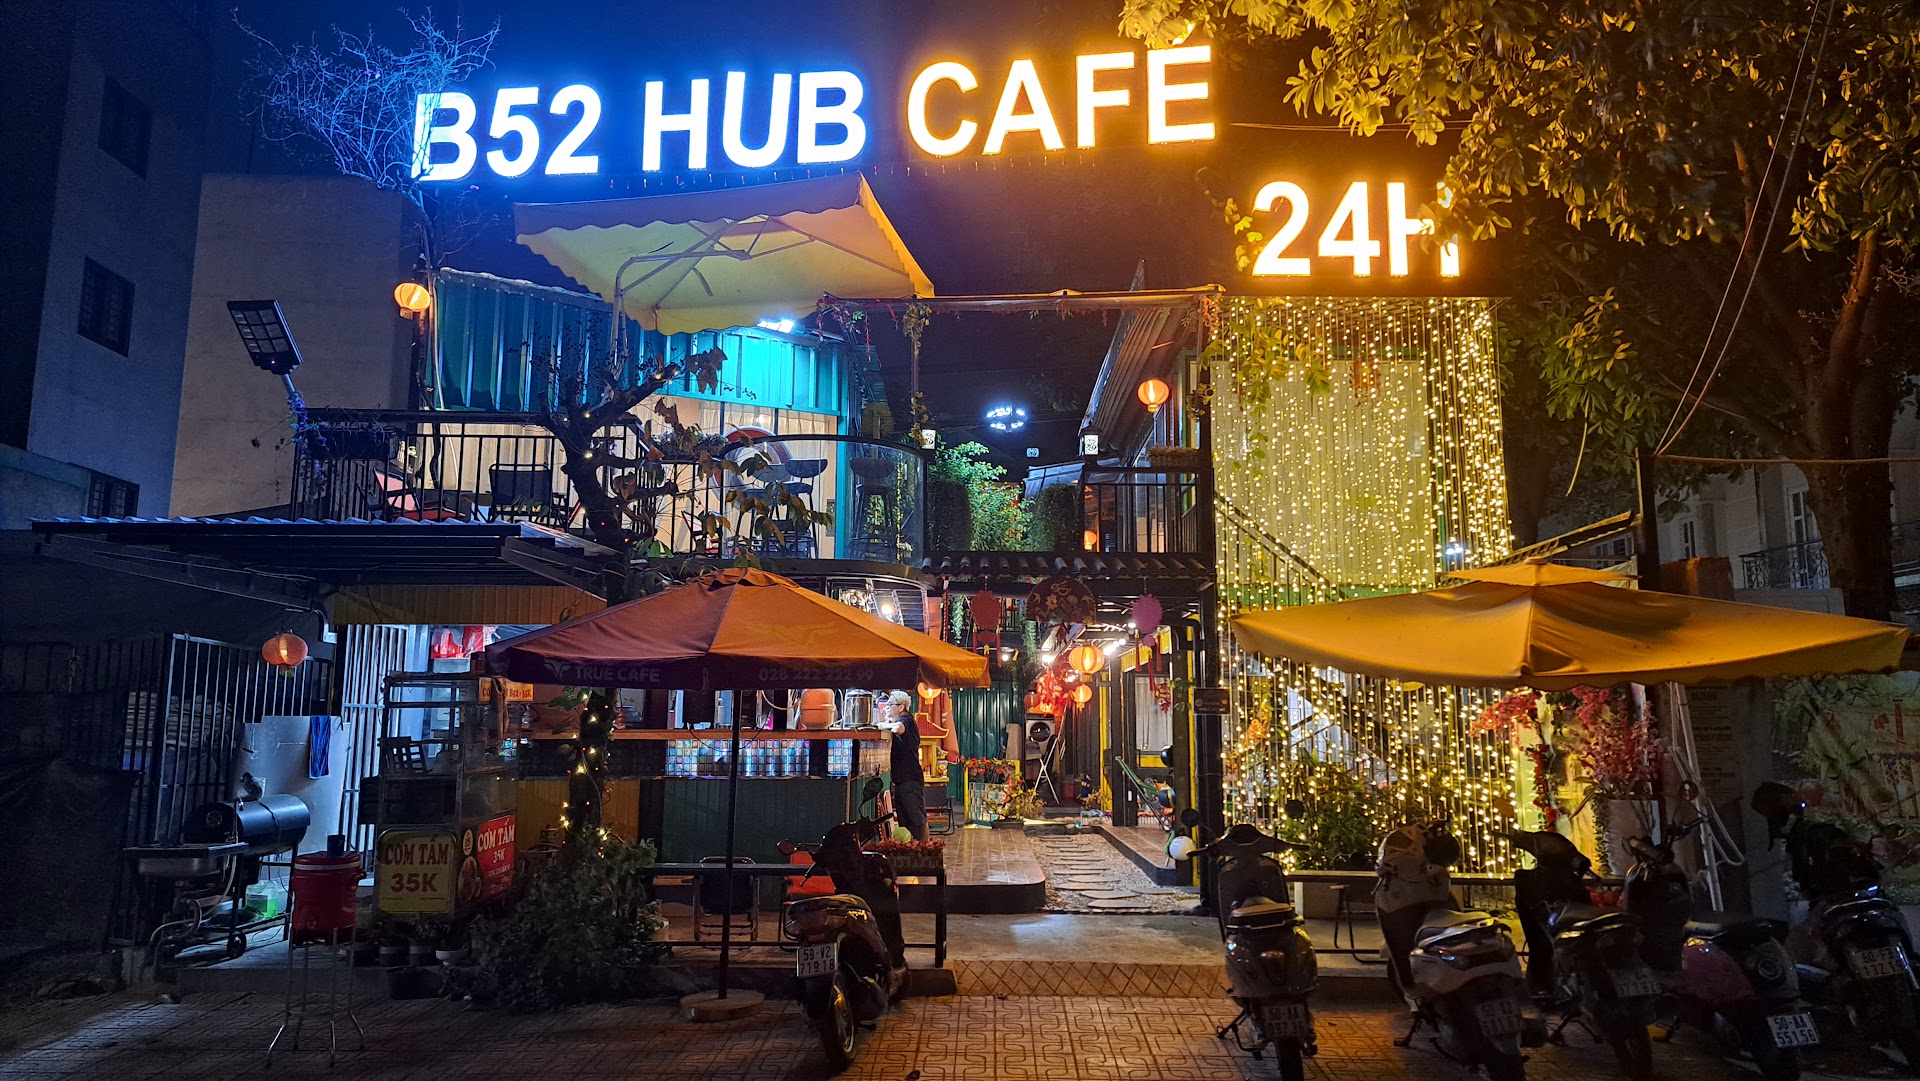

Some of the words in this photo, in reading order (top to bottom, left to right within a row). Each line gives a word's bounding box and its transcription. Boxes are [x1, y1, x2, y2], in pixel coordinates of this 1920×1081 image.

[410, 84, 602, 181] B52
[642, 71, 867, 171] HUB
[1252, 181, 1461, 278] 24H
[575, 664, 614, 680] TRUE
[617, 667, 661, 682] CAFE
[793, 667, 820, 680] 222
[826, 668, 852, 681] 222
[856, 668, 874, 681] 99
[477, 828, 497, 852] CƠM
[497, 818, 516, 846] TẤM
[385, 840, 415, 865] CƠM
[391, 873, 438, 893] 35K
[803, 945, 831, 961] 59-V2
